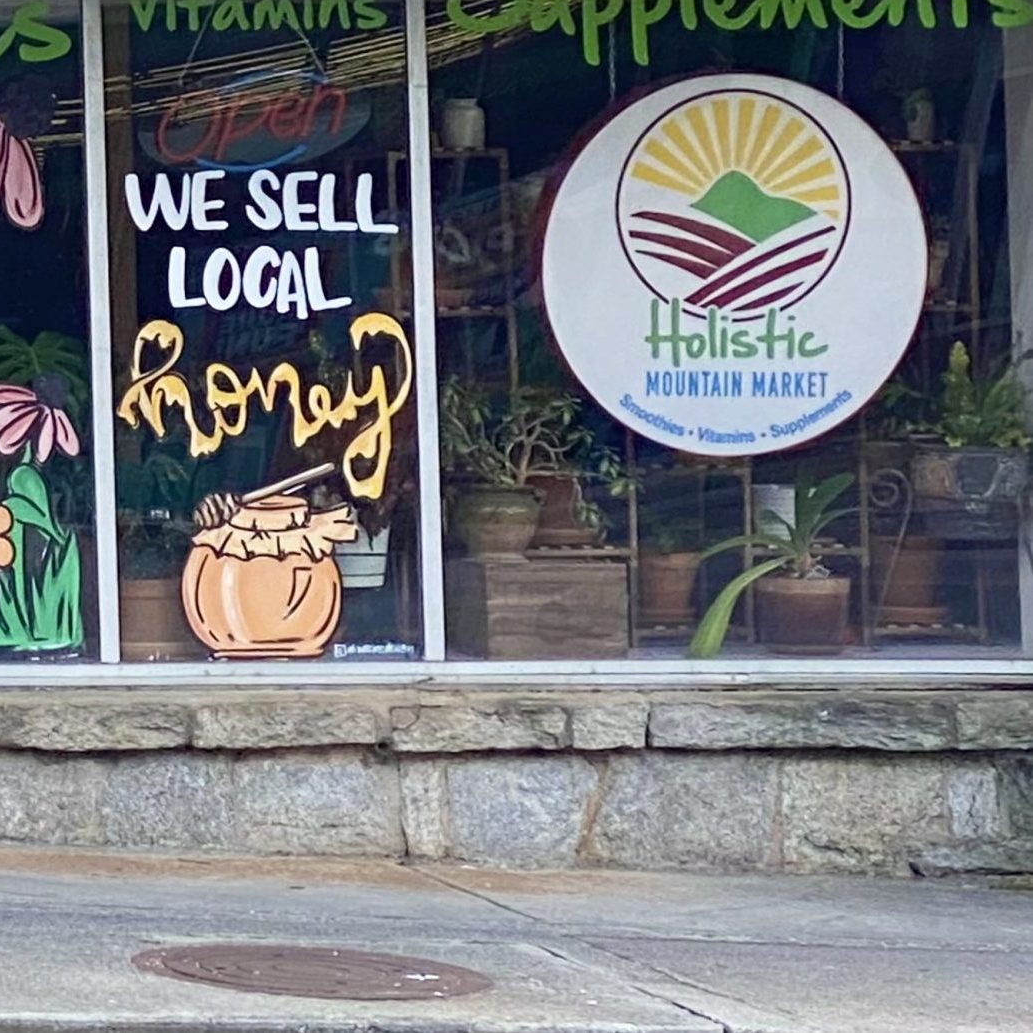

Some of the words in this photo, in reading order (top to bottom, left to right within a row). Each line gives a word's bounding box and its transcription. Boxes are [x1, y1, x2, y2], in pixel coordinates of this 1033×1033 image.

[154, 82, 347, 164] Open
[125, 169, 229, 232] WE
[245, 169, 399, 234] SELL
[168, 245, 352, 319] LOCAL
[645, 297, 828, 367] Holistic
[116, 312, 412, 500] honey
[619, 394, 685, 436] Smoothies
[697, 427, 755, 444] Vitamins
[770, 389, 853, 438] Supplements
[646, 371, 742, 397] MOUNTAIN
[752, 371, 828, 397] MARKET
